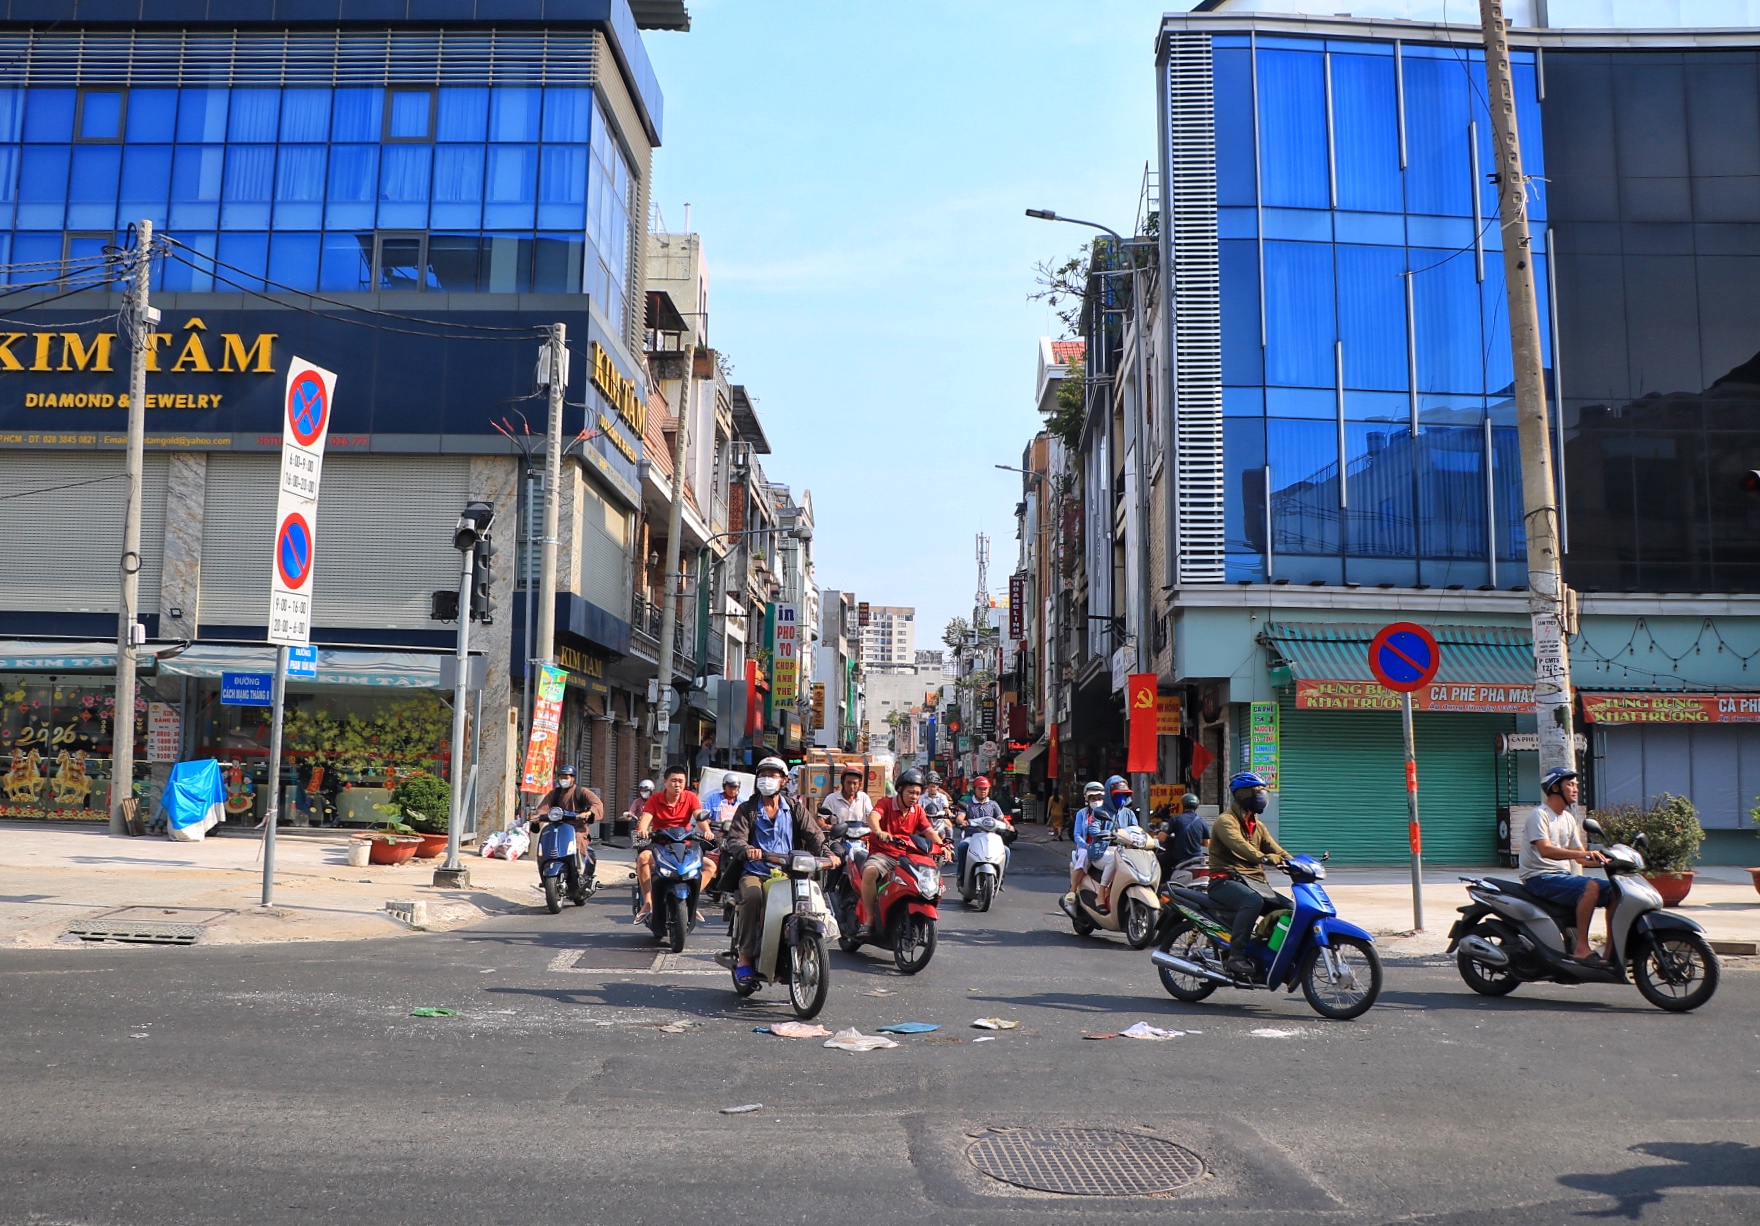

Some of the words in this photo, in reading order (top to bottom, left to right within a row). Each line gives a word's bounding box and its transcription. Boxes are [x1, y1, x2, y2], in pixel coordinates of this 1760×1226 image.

[0, 333, 116, 371] KIM
[25, 393, 114, 408] DIAMOND
[144, 394, 222, 409] EWELRY
[778, 604, 795, 622] in
[777, 625, 795, 639] PHO
[779, 643, 791, 656] TO
[16, 659, 68, 667] KIM
[234, 676, 260, 686] ĐƯỜNG
[222, 685, 236, 699] CÁCH
[250, 687, 266, 700] THÁNG
[1430, 683, 1447, 701] CÀ
[1451, 684, 1477, 702] PHÊ
[1479, 688, 1505, 703] PHA
[1508, 686, 1537, 703] MÁY
[1719, 698, 1737, 713] CÀ
